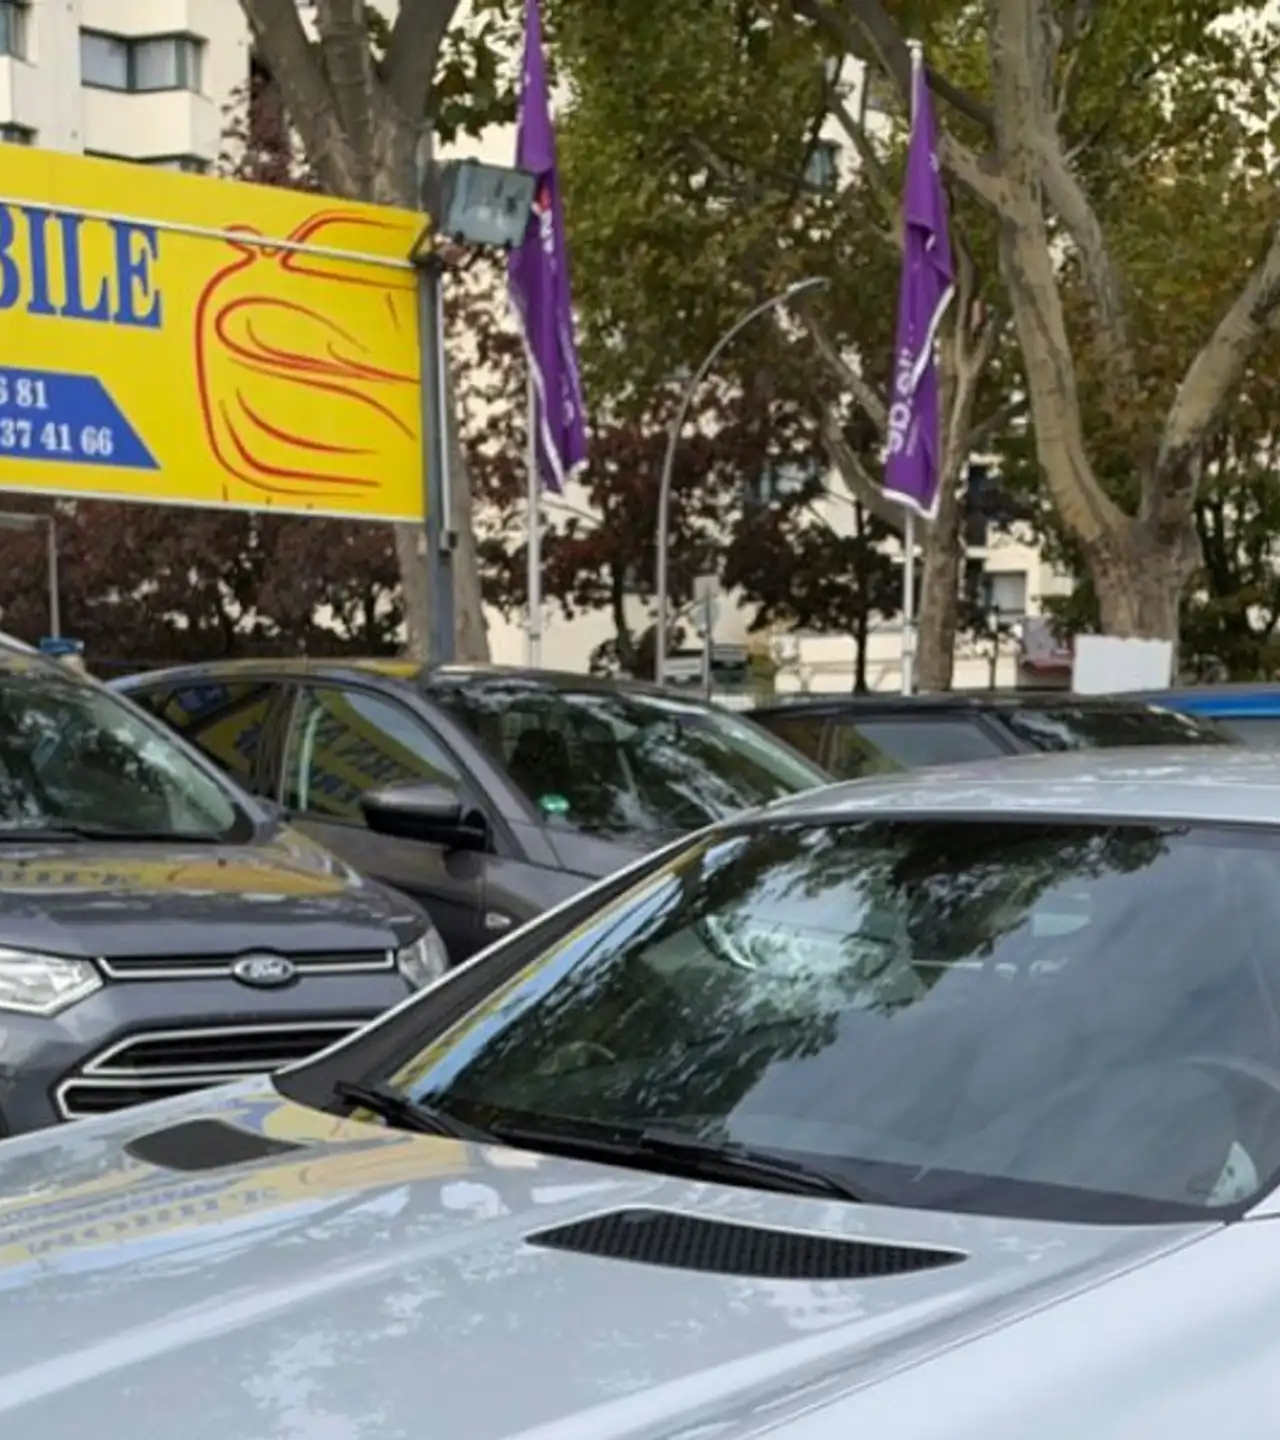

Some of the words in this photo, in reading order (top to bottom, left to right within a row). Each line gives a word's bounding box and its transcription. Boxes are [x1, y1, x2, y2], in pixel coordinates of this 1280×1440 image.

[15, 379, 49, 408] 81
[0, 418, 34, 449] 37
[40, 423, 73, 453] 41
[80, 426, 114, 457] 66
